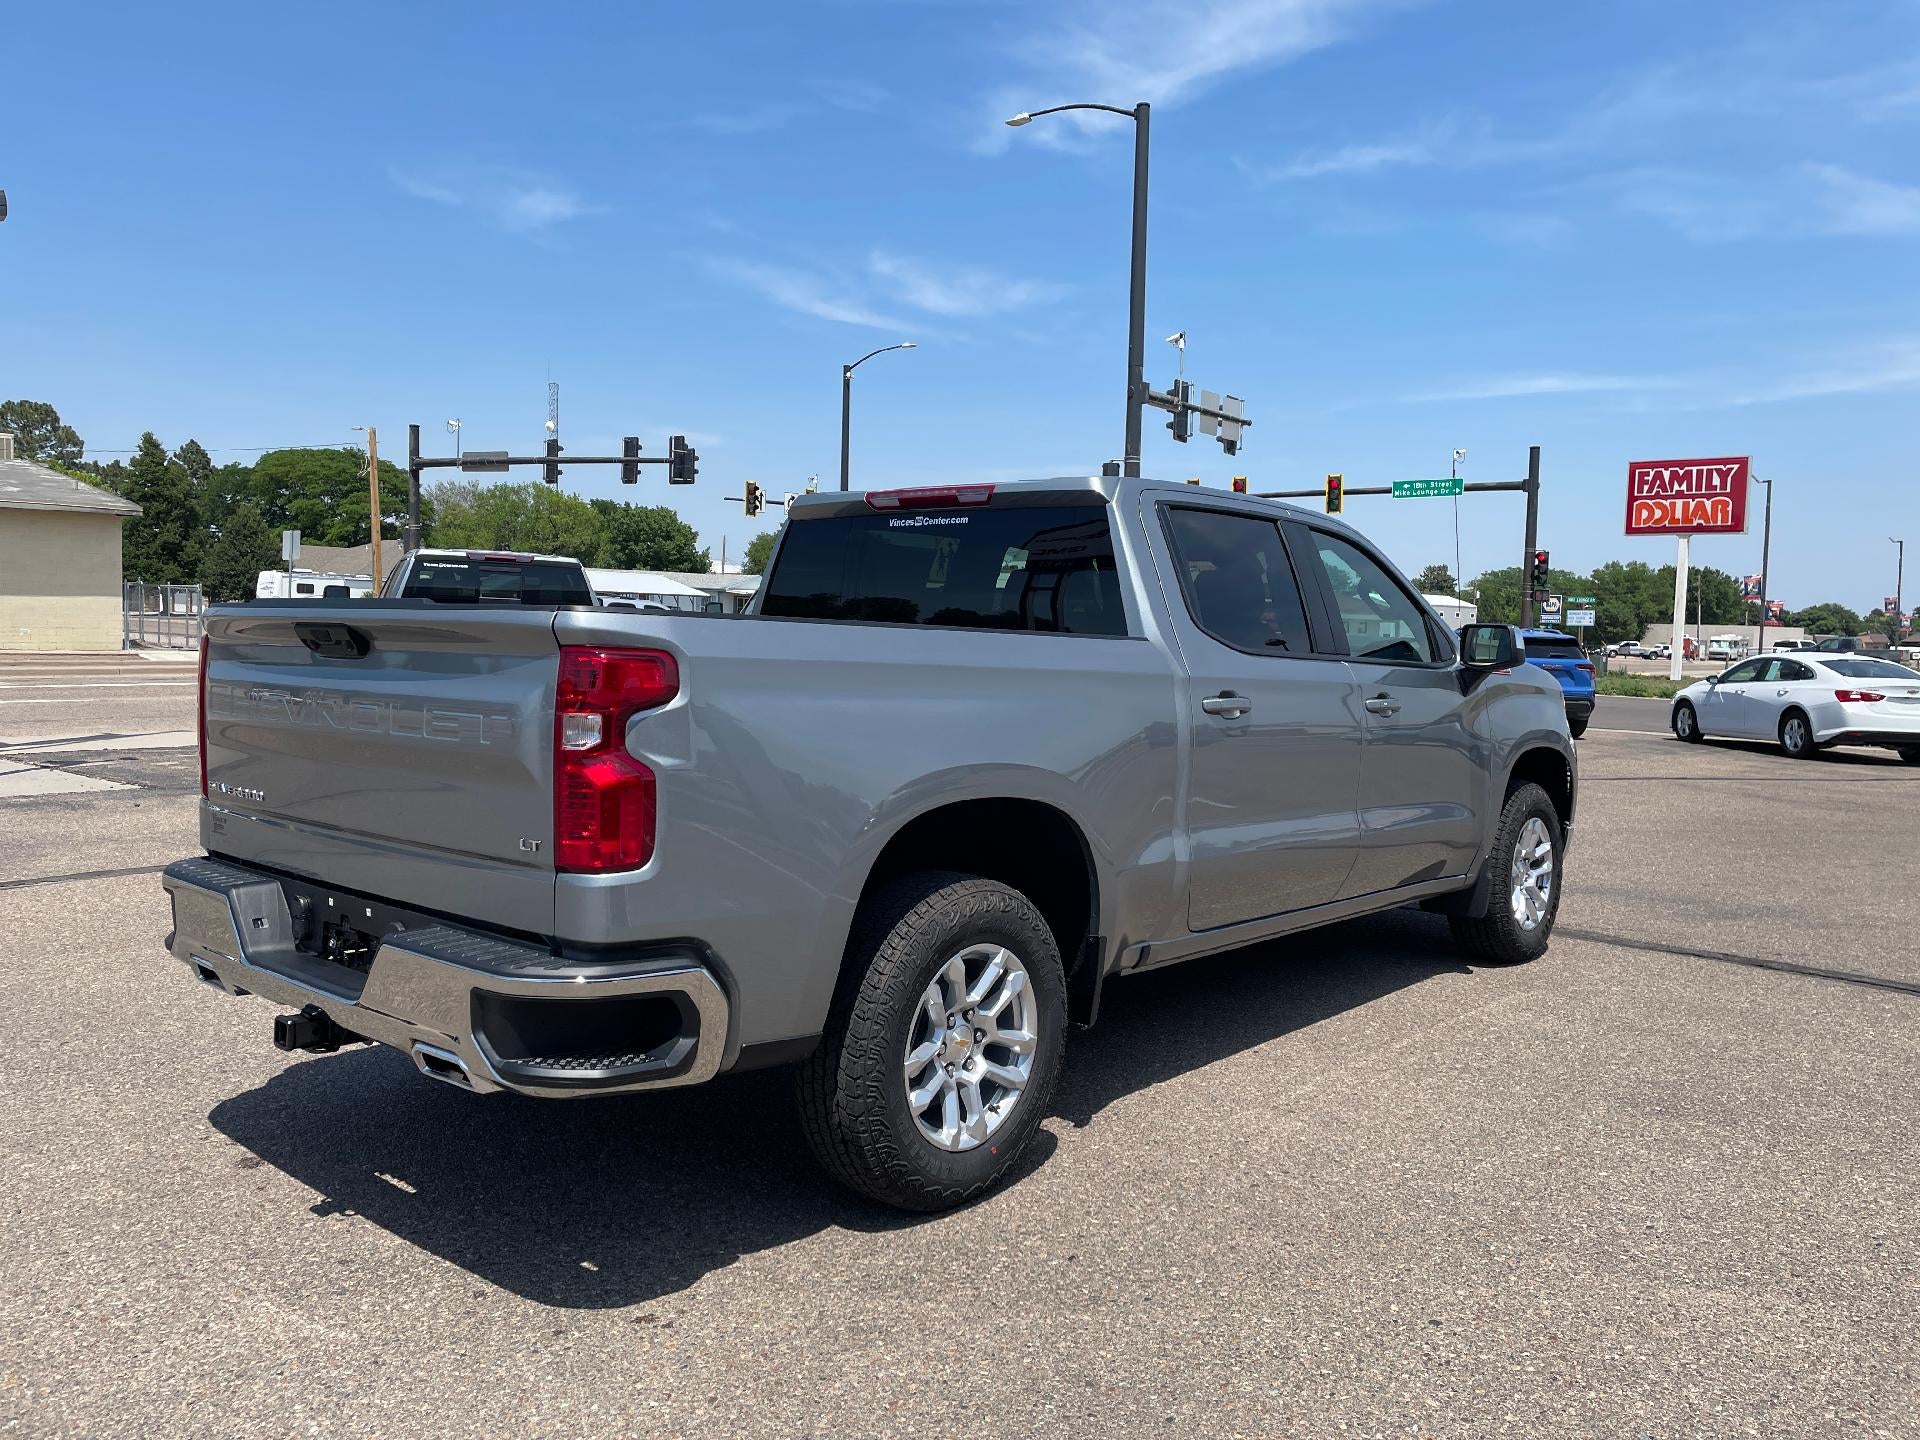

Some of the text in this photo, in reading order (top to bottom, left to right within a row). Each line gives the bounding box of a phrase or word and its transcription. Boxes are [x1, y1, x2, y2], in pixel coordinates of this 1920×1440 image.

[1634, 464, 1740, 496] FAMILY
[1413, 489, 1438, 497] Lounge
[1632, 496, 1733, 528] DOLLAR
[519, 837, 542, 851] LT
